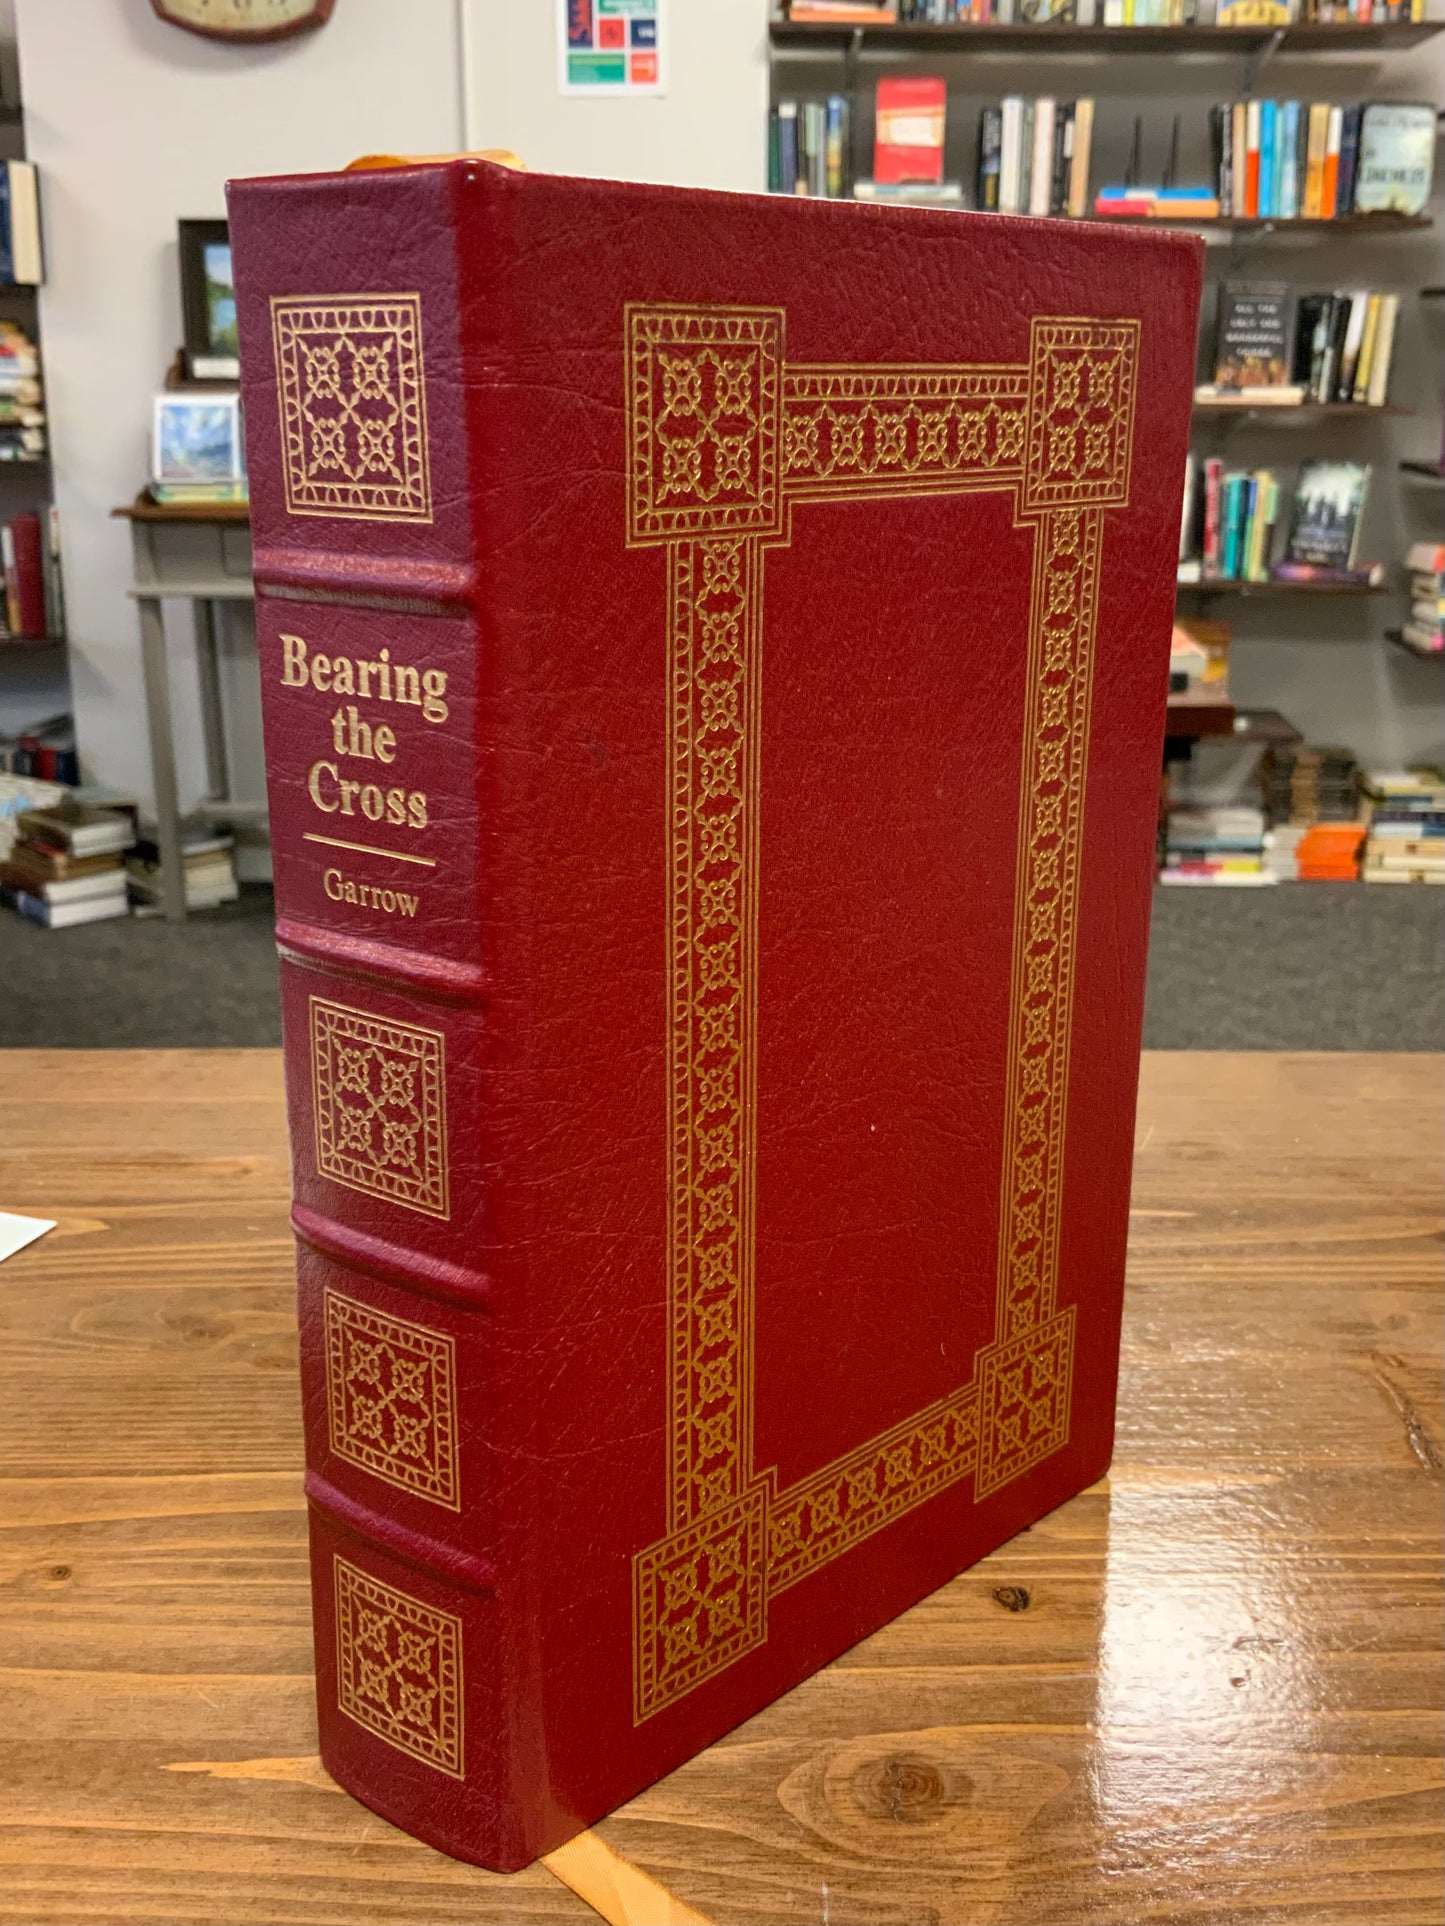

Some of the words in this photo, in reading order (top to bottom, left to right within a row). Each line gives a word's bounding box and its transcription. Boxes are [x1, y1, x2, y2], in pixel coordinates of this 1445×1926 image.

[279, 633, 448, 723] Bearing
[331, 705, 396, 763] the
[308, 760, 428, 829] Cross
[323, 867, 419, 918] Garrow
